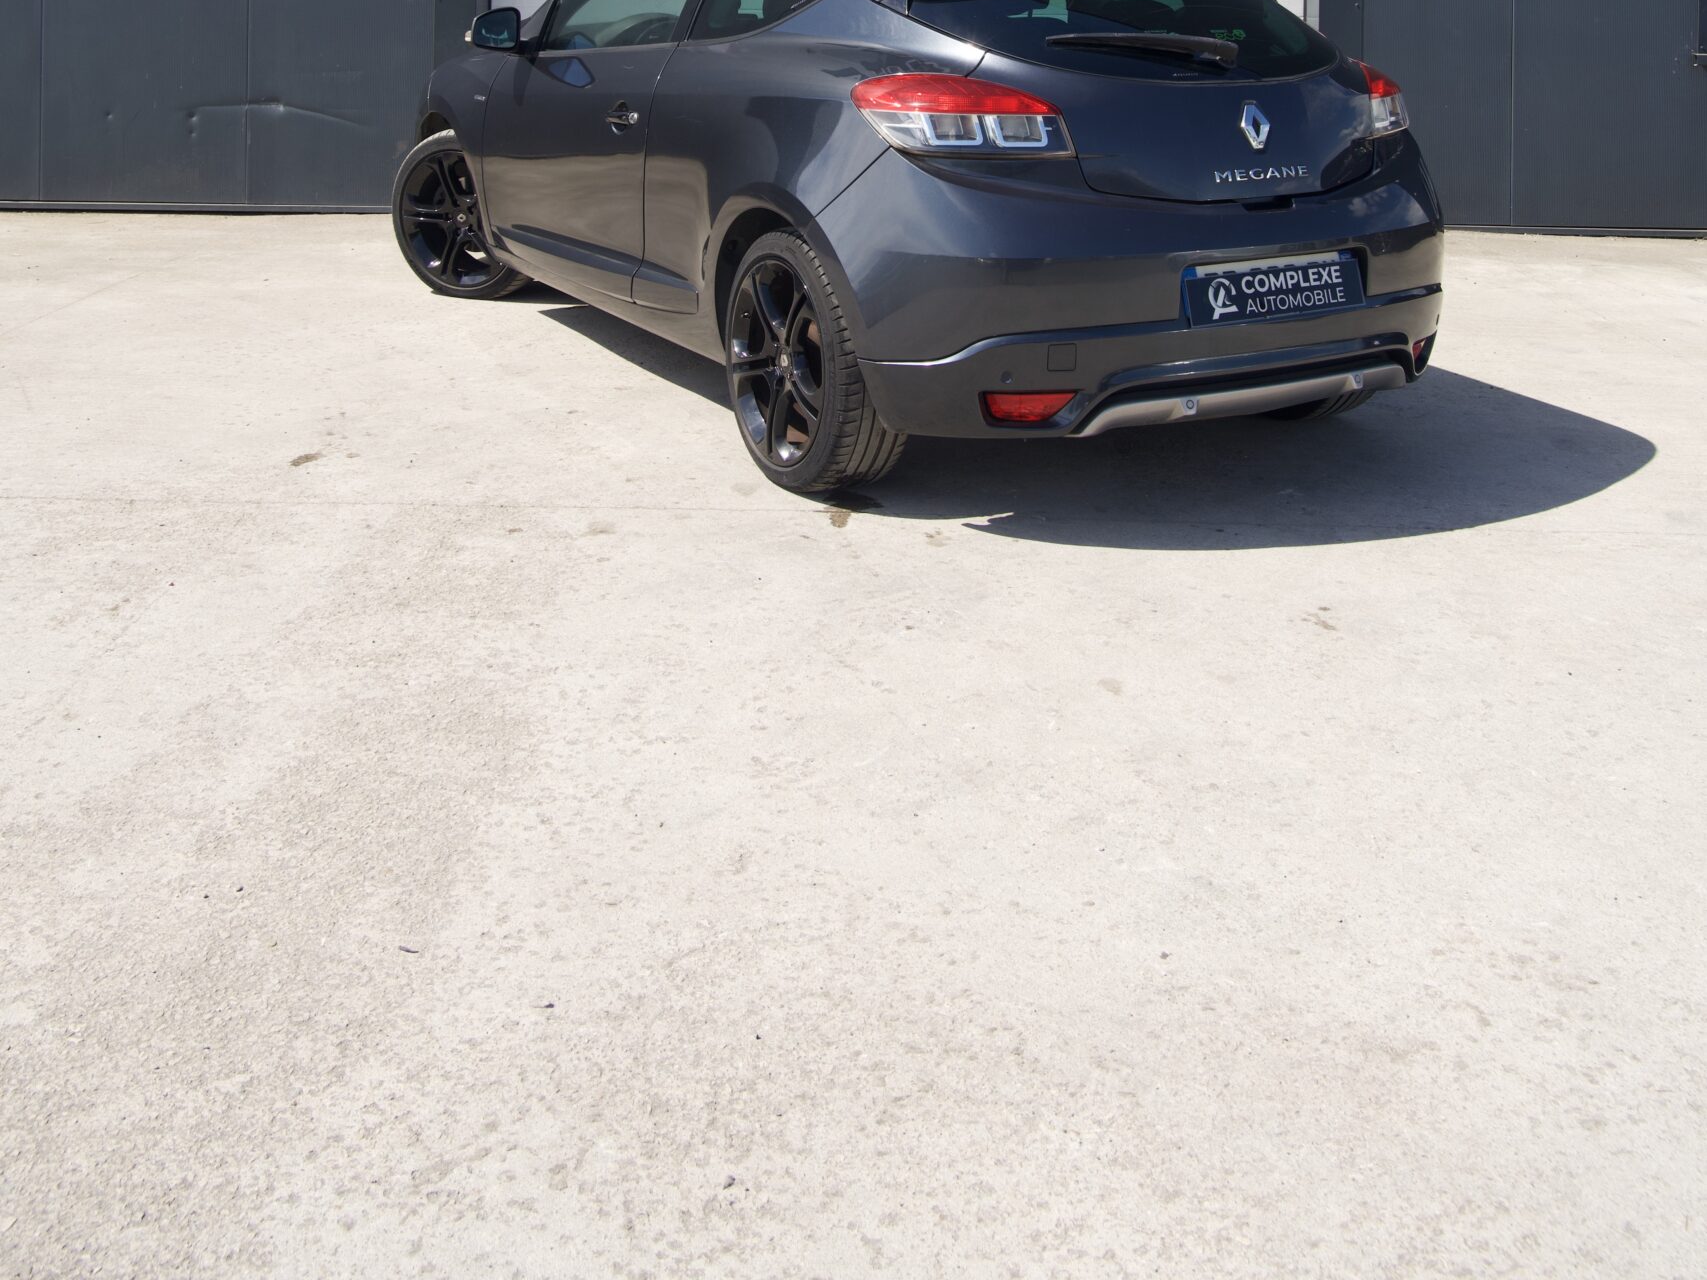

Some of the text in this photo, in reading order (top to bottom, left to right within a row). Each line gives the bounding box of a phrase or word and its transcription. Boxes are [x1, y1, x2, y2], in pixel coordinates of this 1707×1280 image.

[1214, 165, 1309, 183] MEGANE
[1241, 265, 1343, 294] COMPLEXE
[1246, 287, 1346, 314] AUTOMOBILE
